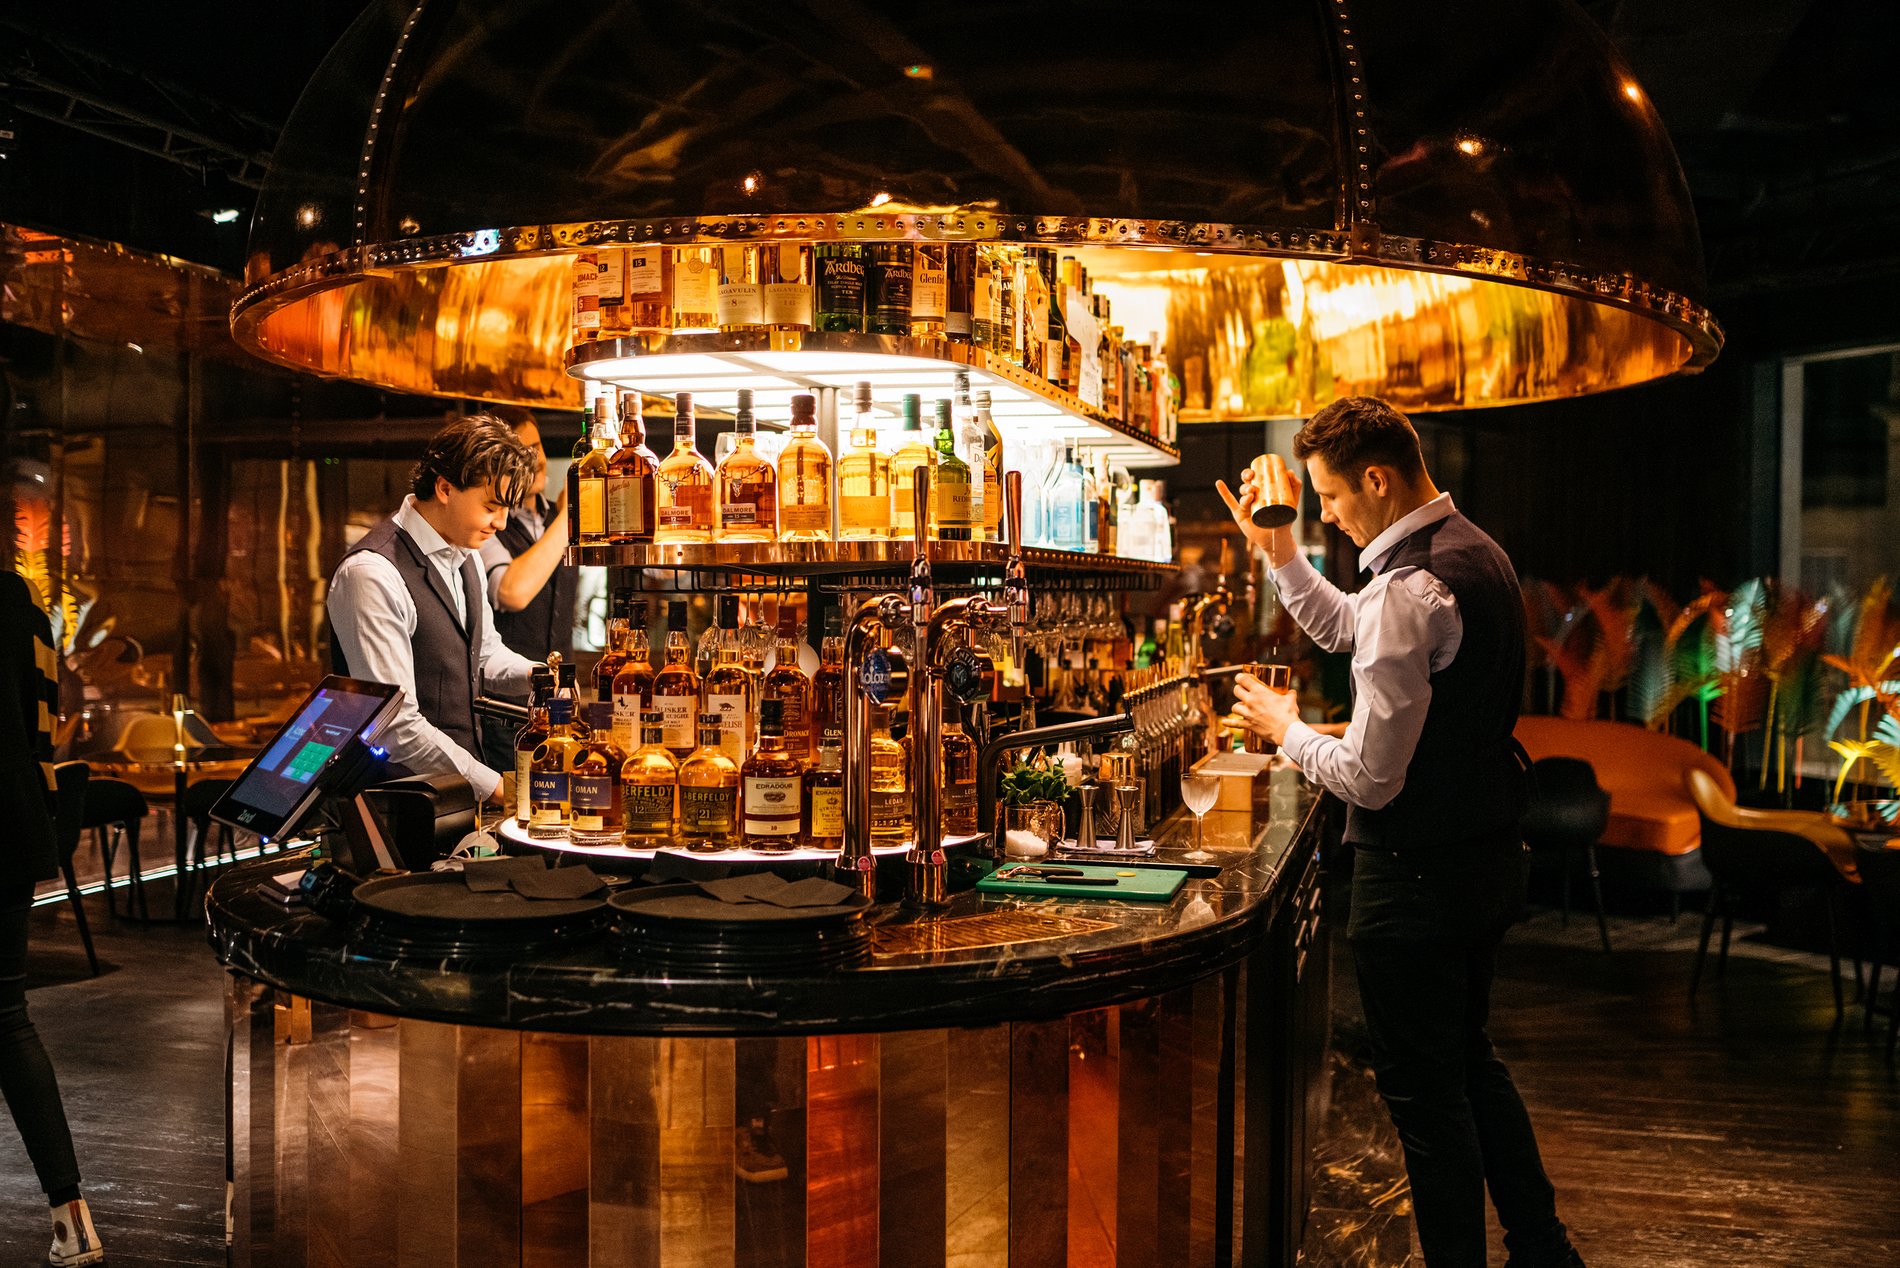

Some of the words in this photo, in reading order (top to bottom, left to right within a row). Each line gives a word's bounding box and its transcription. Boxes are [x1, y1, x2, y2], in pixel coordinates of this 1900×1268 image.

[661, 509, 689, 517] DALMORE
[824, 728, 842, 736] GLEN
[534, 780, 556, 789] OMAN
[575, 786, 598, 794] OMAN
[683, 791, 730, 802] ABERFELDY
[634, 806, 645, 814] 12
[699, 809, 710, 819] 21
